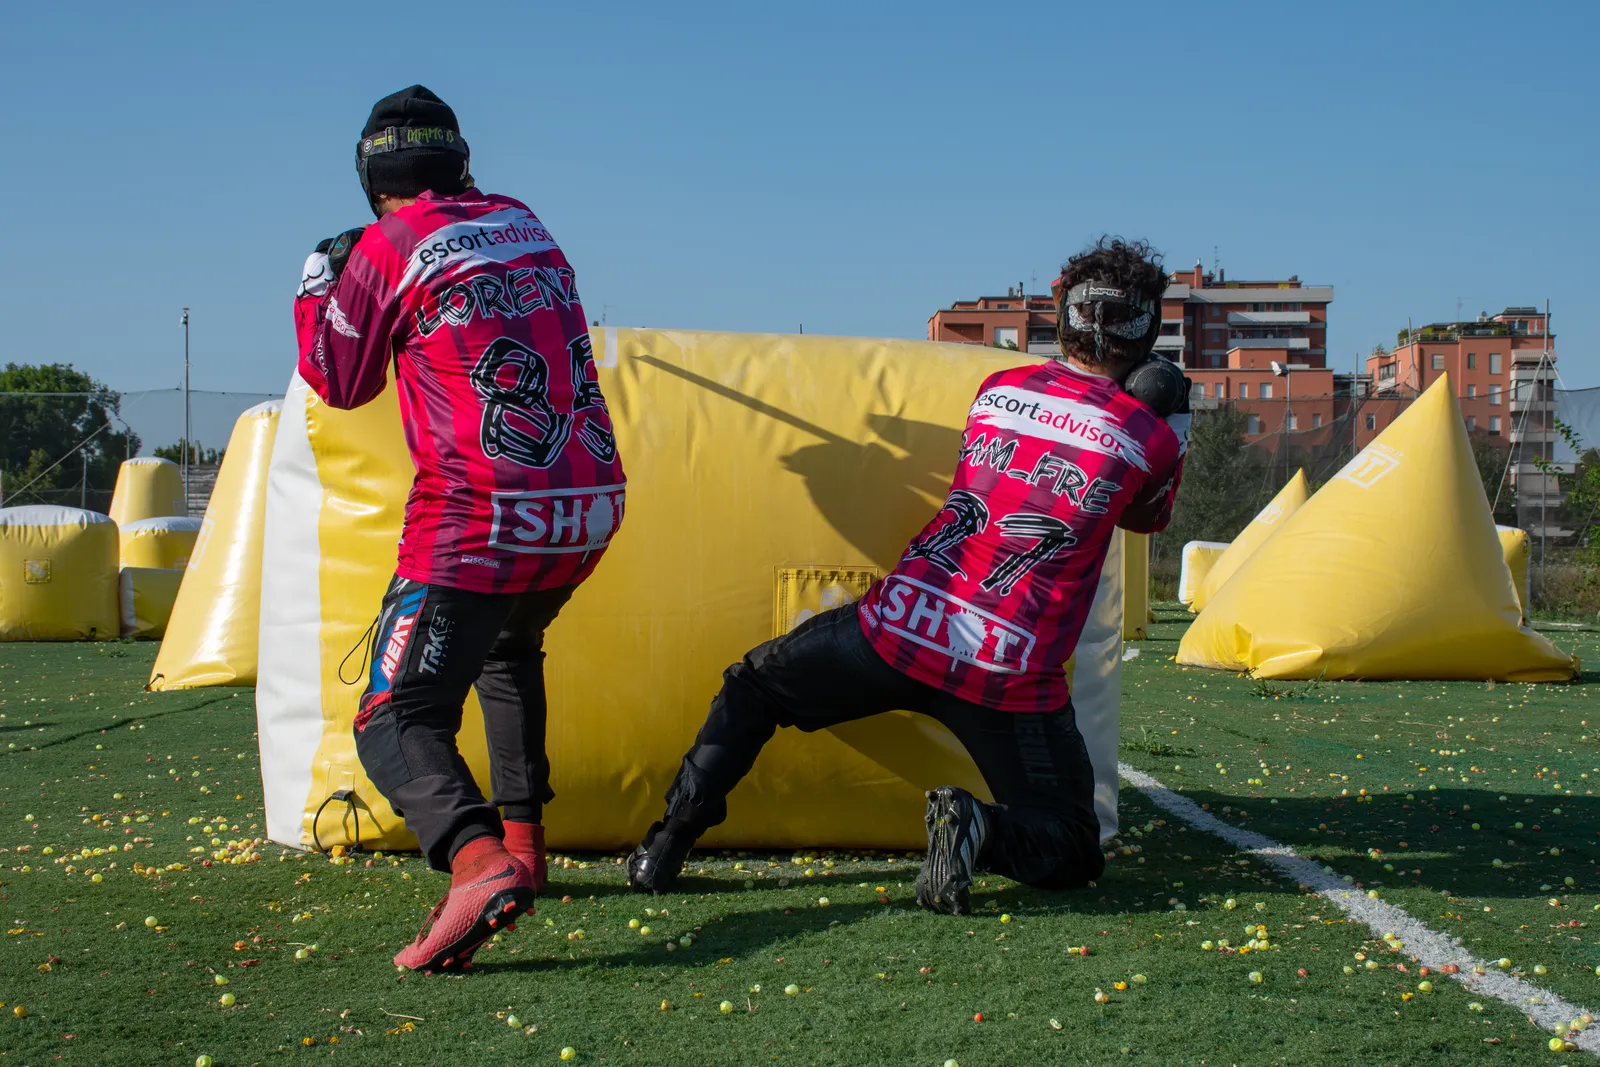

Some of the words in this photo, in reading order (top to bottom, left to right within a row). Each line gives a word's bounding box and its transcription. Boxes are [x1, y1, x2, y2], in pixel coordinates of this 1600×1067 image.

[977, 392, 1125, 453] escortadvisor
[381, 615, 415, 680] HEAT
[418, 627, 447, 675] TRK
